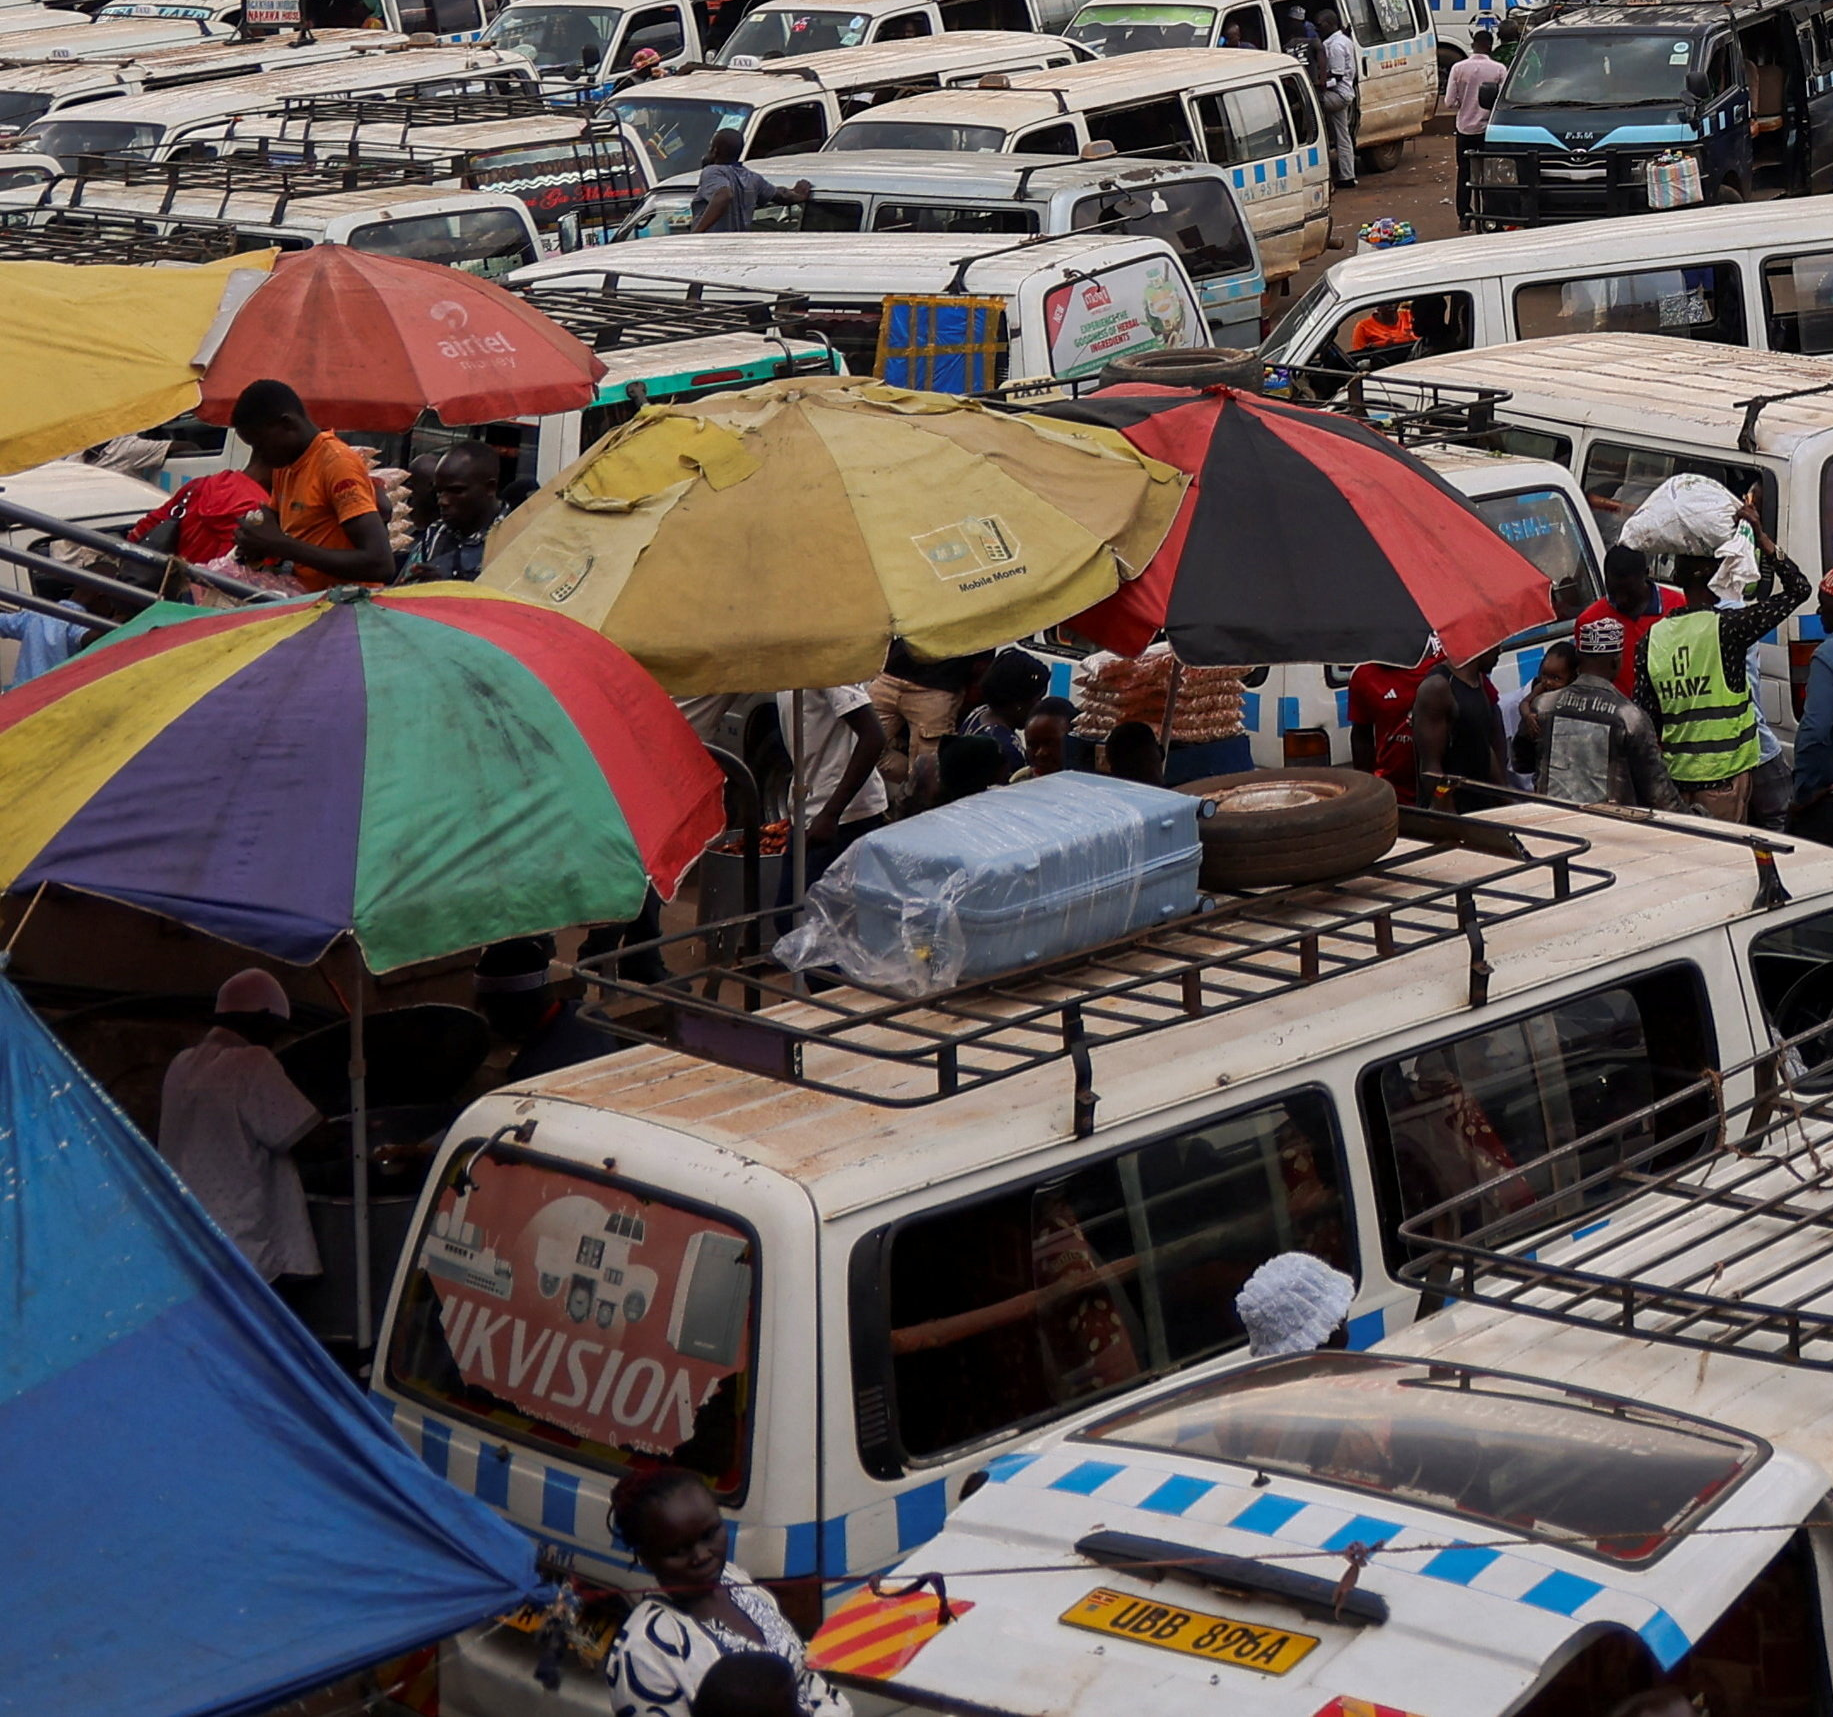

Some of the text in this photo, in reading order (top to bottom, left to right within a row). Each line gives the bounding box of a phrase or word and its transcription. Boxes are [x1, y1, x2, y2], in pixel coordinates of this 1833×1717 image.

[437, 330, 517, 359] airtel
[958, 565, 1028, 593] Mobile Money
[1108, 1601, 1291, 1665] UBB 896A
